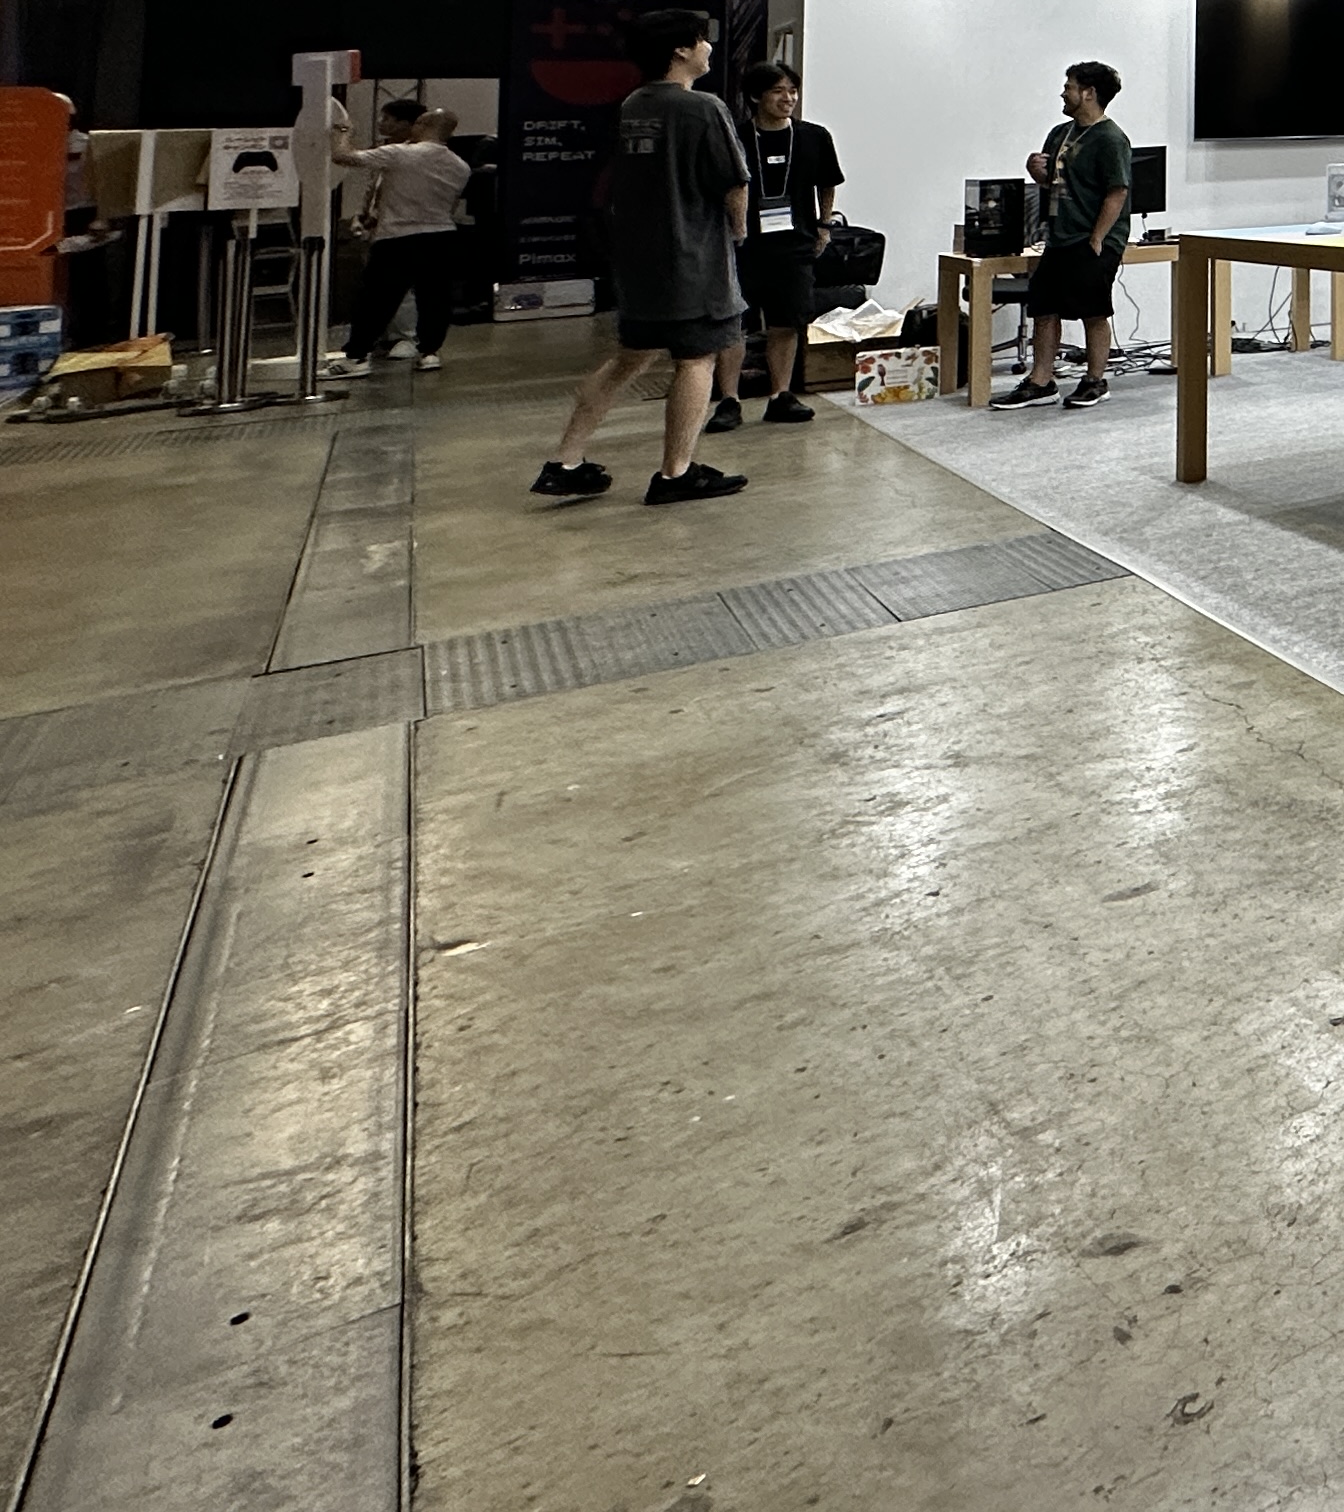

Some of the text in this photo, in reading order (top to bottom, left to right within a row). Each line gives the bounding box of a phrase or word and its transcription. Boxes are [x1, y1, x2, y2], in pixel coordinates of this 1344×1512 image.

[523, 120, 586, 131] DRIFT,
[523, 136, 563, 146] SIM,
[522, 150, 596, 161] REPEAT
